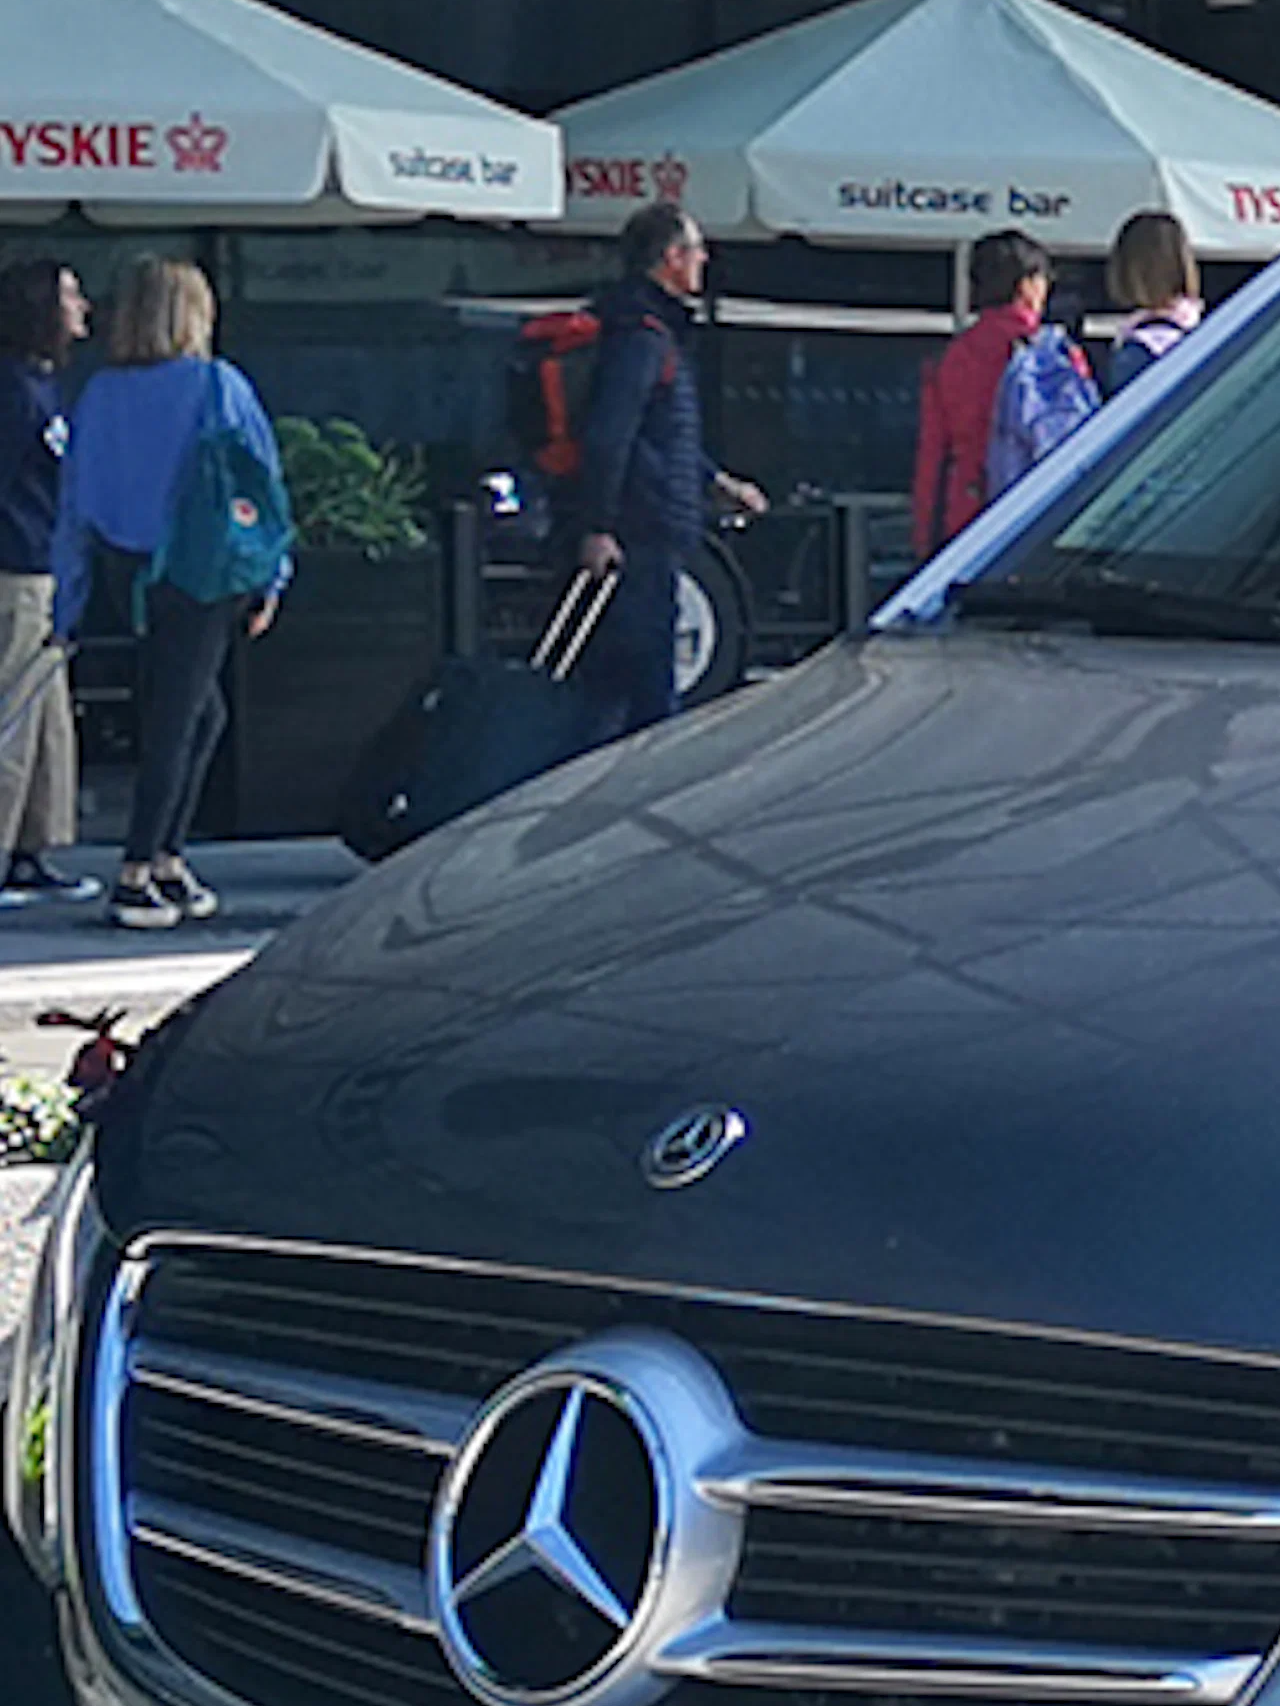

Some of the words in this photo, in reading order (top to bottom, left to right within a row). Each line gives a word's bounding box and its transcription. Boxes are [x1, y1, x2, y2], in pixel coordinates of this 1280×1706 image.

[0, 121, 157, 167] YSKIE
[480, 152, 518, 186] bar
[838, 180, 990, 213] suitcase
[1007, 186, 1071, 219] bar
